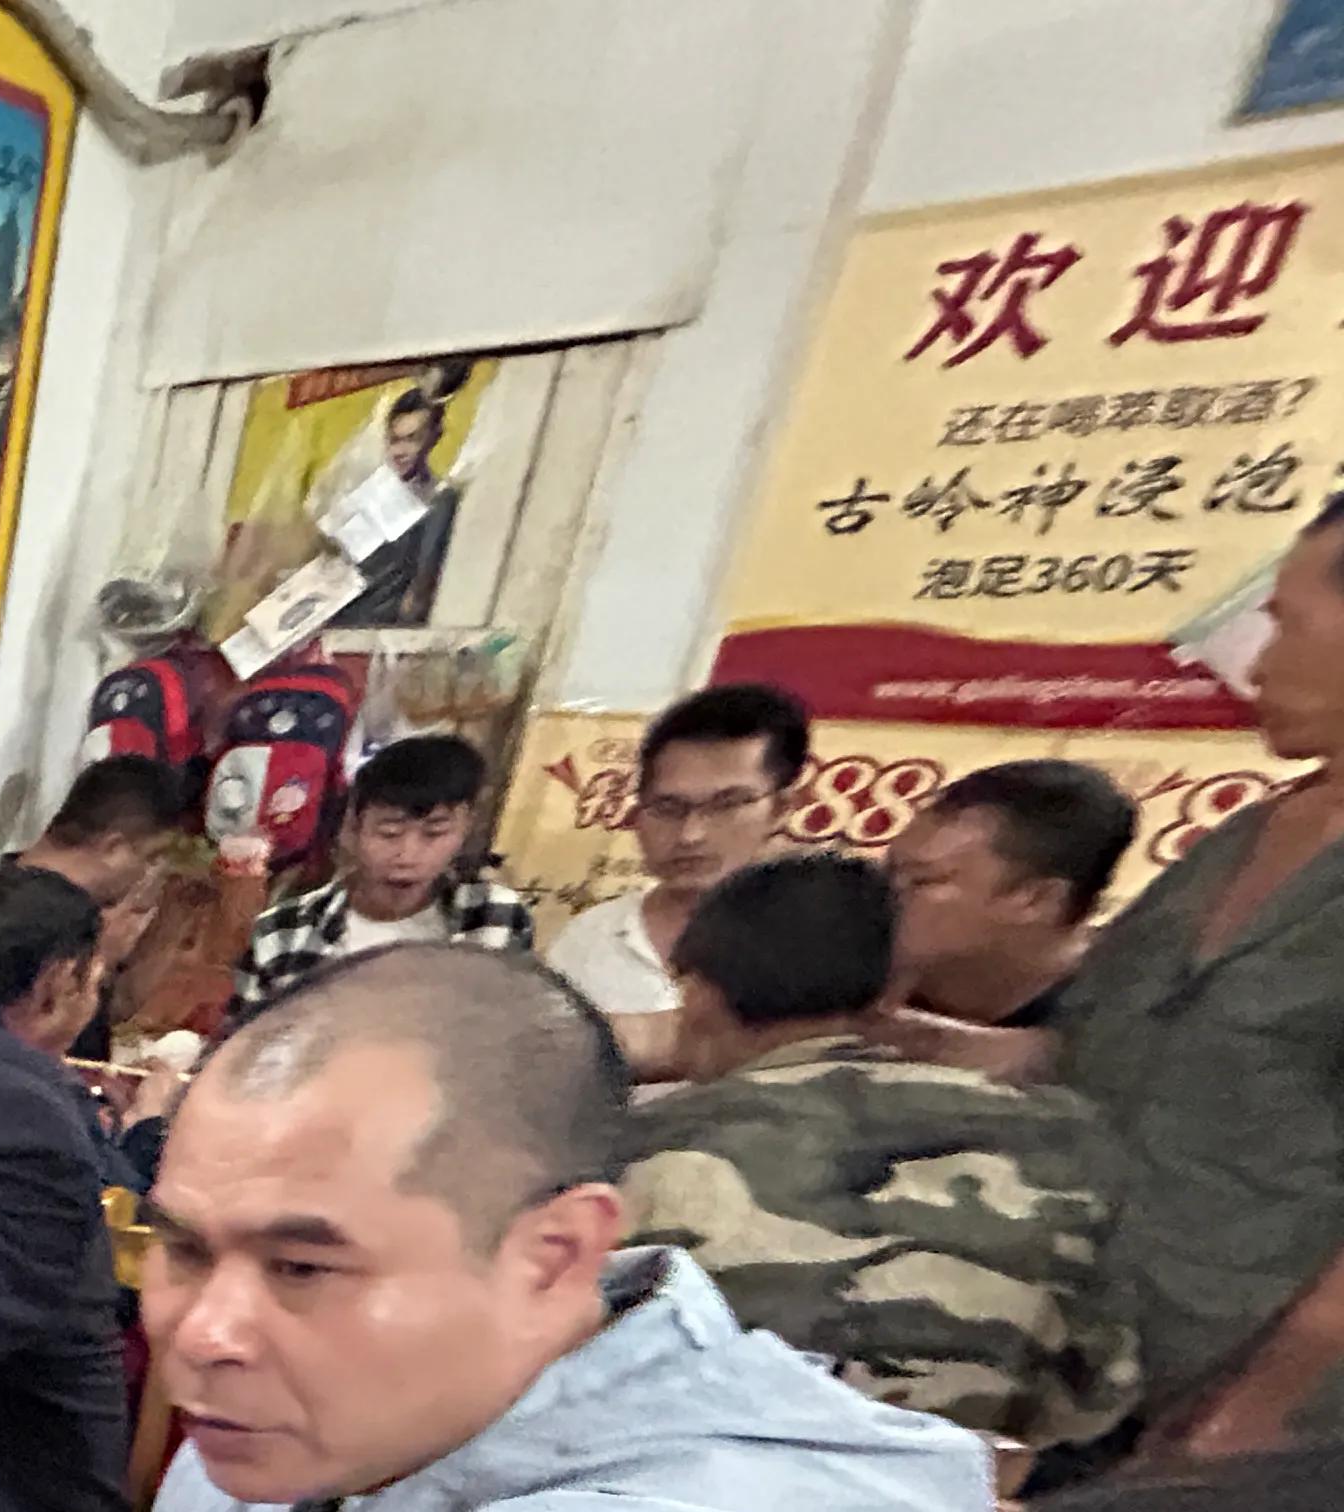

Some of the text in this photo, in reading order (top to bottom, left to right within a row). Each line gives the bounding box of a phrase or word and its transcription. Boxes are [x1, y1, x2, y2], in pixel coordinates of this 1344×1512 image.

[900, 199, 1344, 369] 欢迎
[816, 440, 1344, 535] 古岭神浸泡
[913, 546, 1197, 602] 泡足360天
